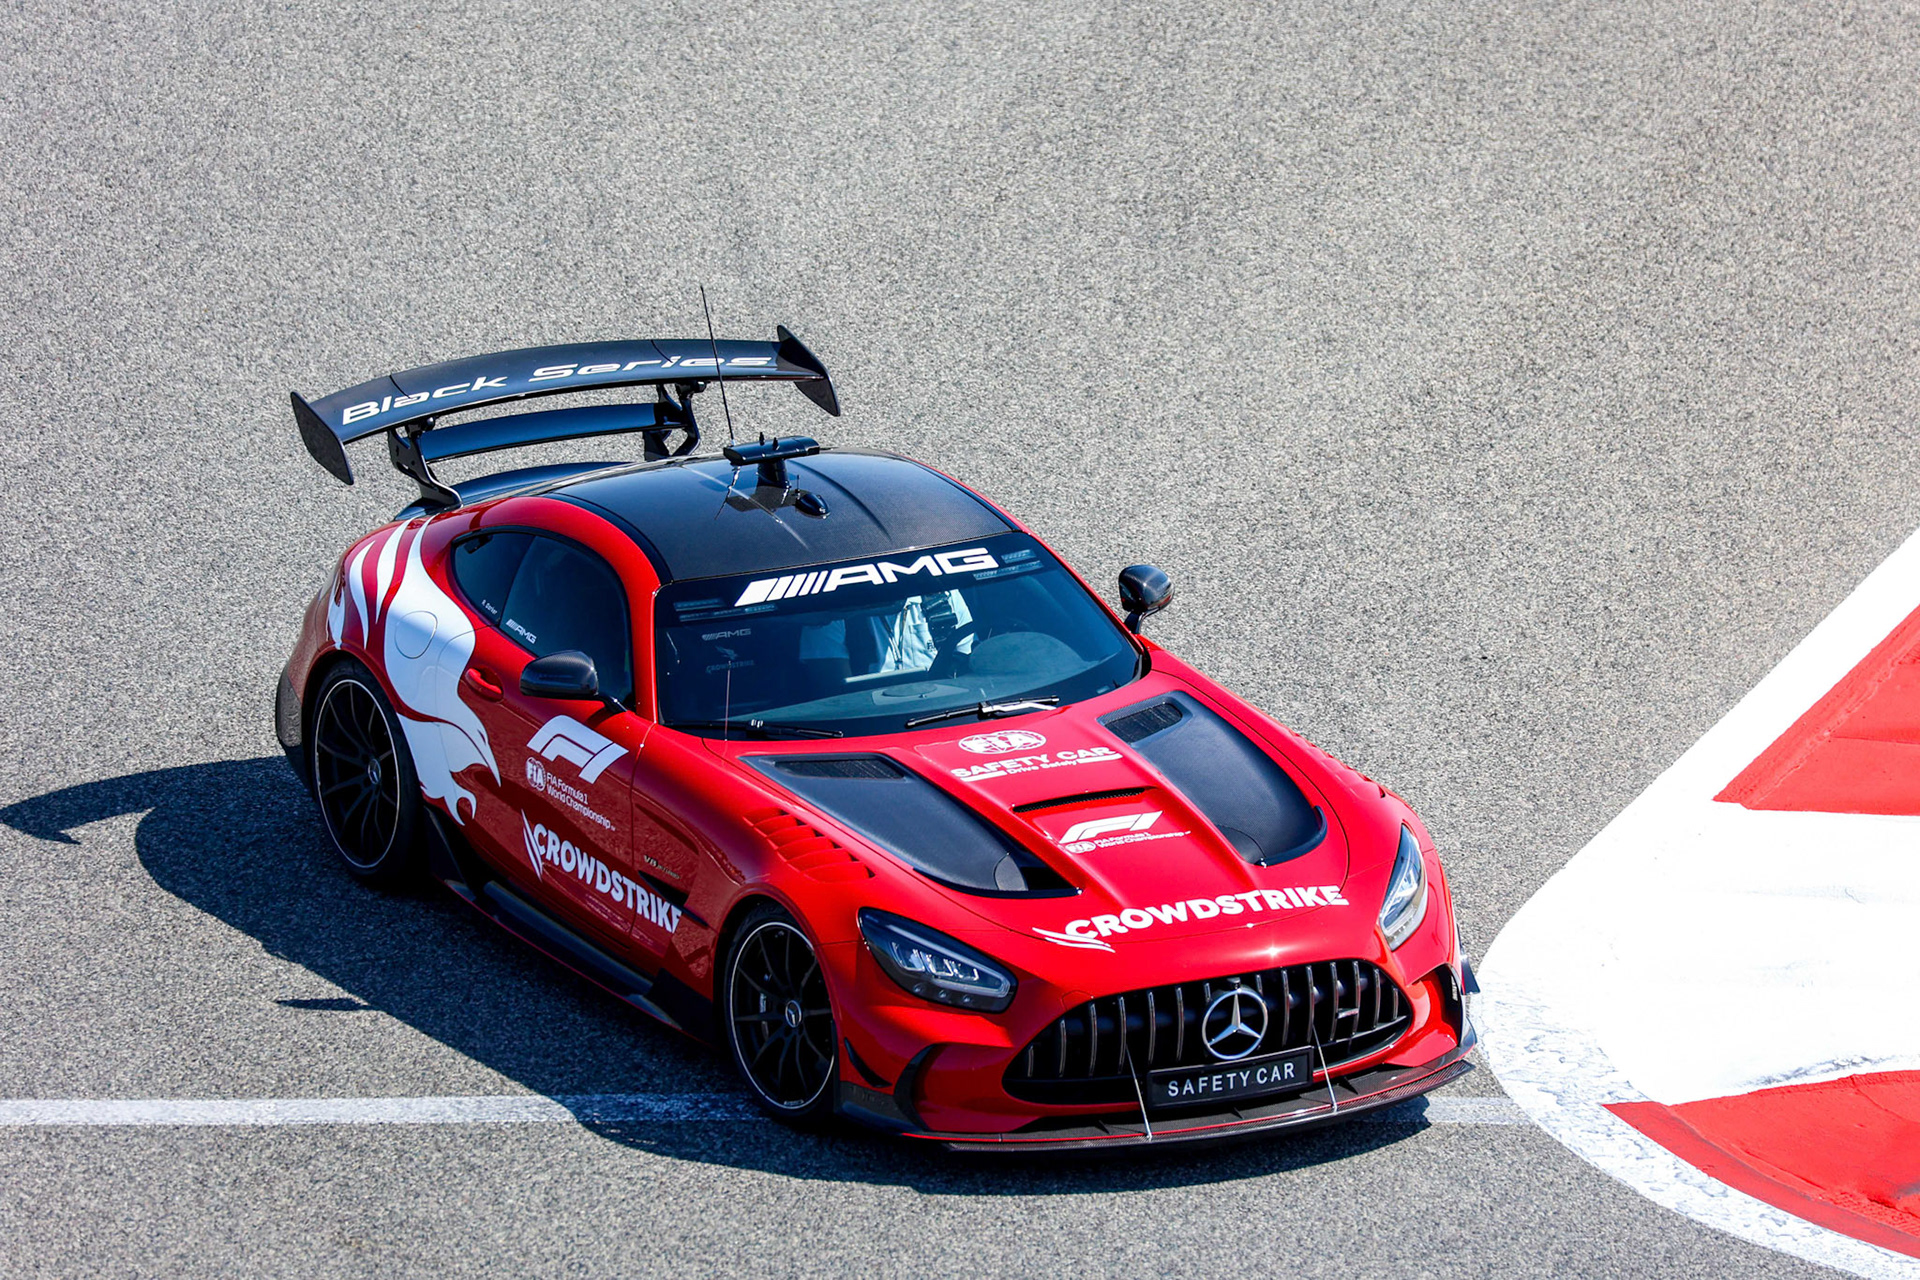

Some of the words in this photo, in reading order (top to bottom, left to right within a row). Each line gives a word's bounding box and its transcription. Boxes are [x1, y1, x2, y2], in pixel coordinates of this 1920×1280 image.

[342, 376, 508, 425] Black
[528, 356, 772, 382] Series
[822, 548, 999, 592] AMG
[526, 714, 630, 784] F1
[966, 733, 1036, 752] FIA
[526, 760, 545, 790] FIA
[950, 754, 1049, 778] SAFETY
[1056, 747, 1117, 760] CAR
[1007, 765, 1040, 775] Drive
[546, 773, 558, 788] FIA
[557, 779, 585, 803] Formula
[547, 784, 566, 803] World
[565, 795, 611, 829] Championship
[1059, 811, 1163, 843] F1
[1064, 885, 1349, 940] CROWDSTRIKE
[1168, 1071, 1250, 1097] SAFETY
[1256, 1063, 1295, 1084] CAR
